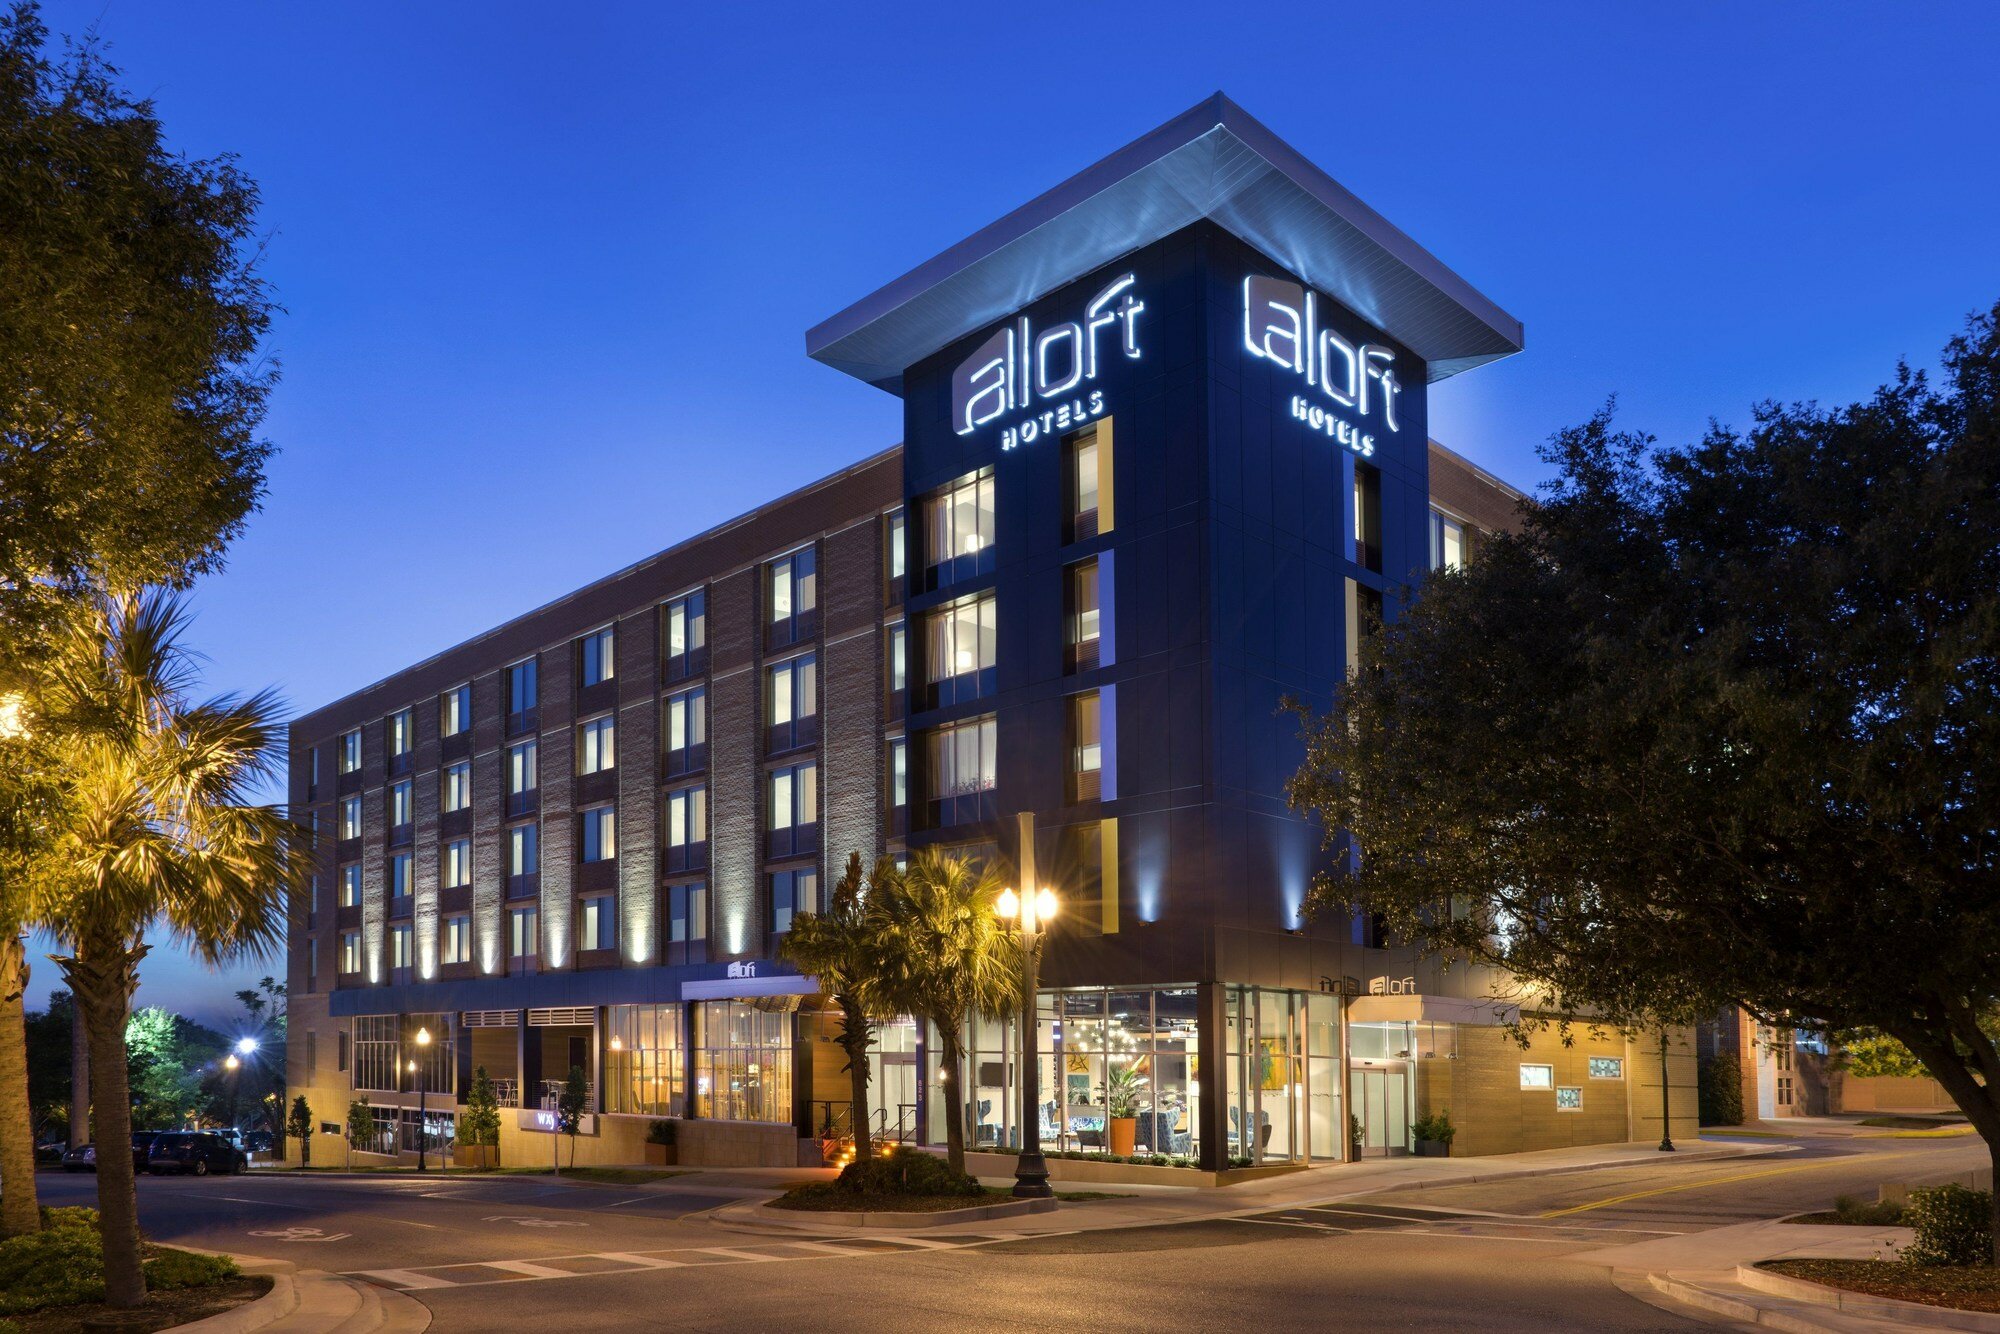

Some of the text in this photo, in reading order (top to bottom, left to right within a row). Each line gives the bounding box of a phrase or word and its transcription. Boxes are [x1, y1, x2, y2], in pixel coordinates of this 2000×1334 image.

[953, 274, 1144, 436] aloft
[1244, 275, 1401, 433] aloft
[1001, 391, 1103, 451] HOTELS
[1291, 394, 1376, 457] HOTELS
[1369, 976, 1416, 994] aloft
